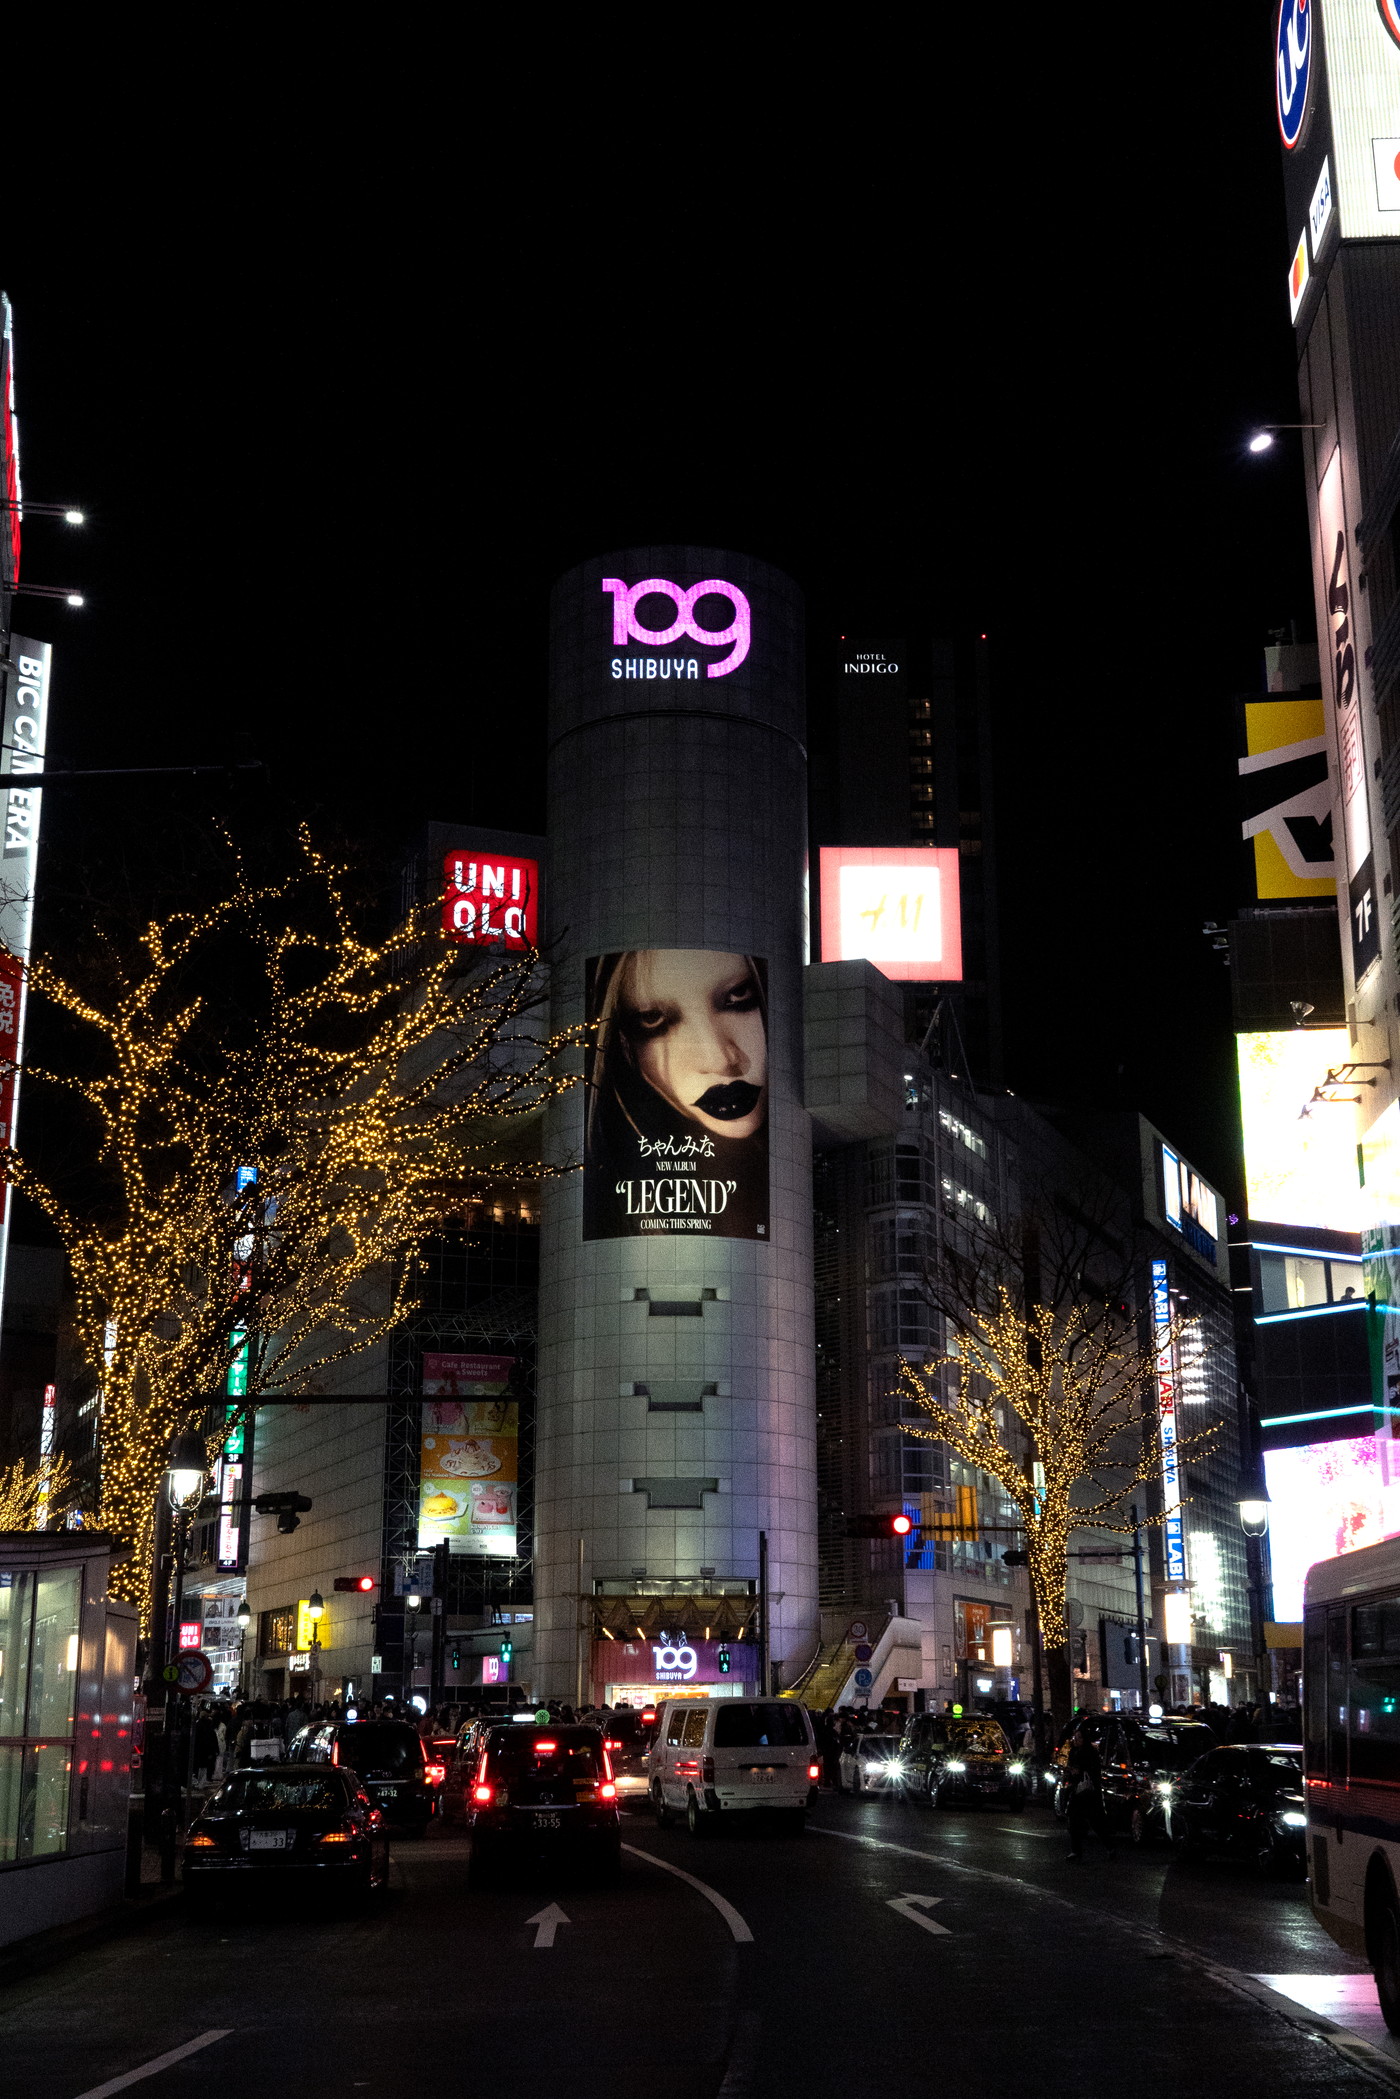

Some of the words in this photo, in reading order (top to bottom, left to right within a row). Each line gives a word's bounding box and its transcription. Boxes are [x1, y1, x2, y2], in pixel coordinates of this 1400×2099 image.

[1312, 176, 1329, 234] VISA
[602, 578, 751, 678] 109
[611, 658, 699, 679] SHIBUYA
[844, 663, 899, 674] INDIGO
[16, 655, 43, 709] BIC
[454, 861, 521, 900] UNI
[453, 900, 526, 939] QLO
[1355, 888, 1372, 944] 7F
[637, 1134, 716, 1157] ちゃんみな
[656, 1161, 673, 1172] NEW
[673, 1161, 696, 1172] ALBUM
[640, 1219, 669, 1230] COMING
[669, 1218, 686, 1229] THIS
[686, 1219, 711, 1230] SPRING
[1153, 1279, 1169, 1319] LABI
[460, 1361, 501, 1370] Restaurant
[228, 1454, 239, 1462] 3F
[1163, 1427, 1176, 1484] SHIBUYA
[1167, 1538, 1184, 1581] LABI
[181, 1625, 198, 1636] UNI
[853, 1625, 863, 1634] 30
[181, 1636, 199, 1647] QLO
[652, 1646, 697, 1680] 109
[655, 1671, 682, 1681] SHIBUYA
[537, 1818, 561, 1828] 33-55
